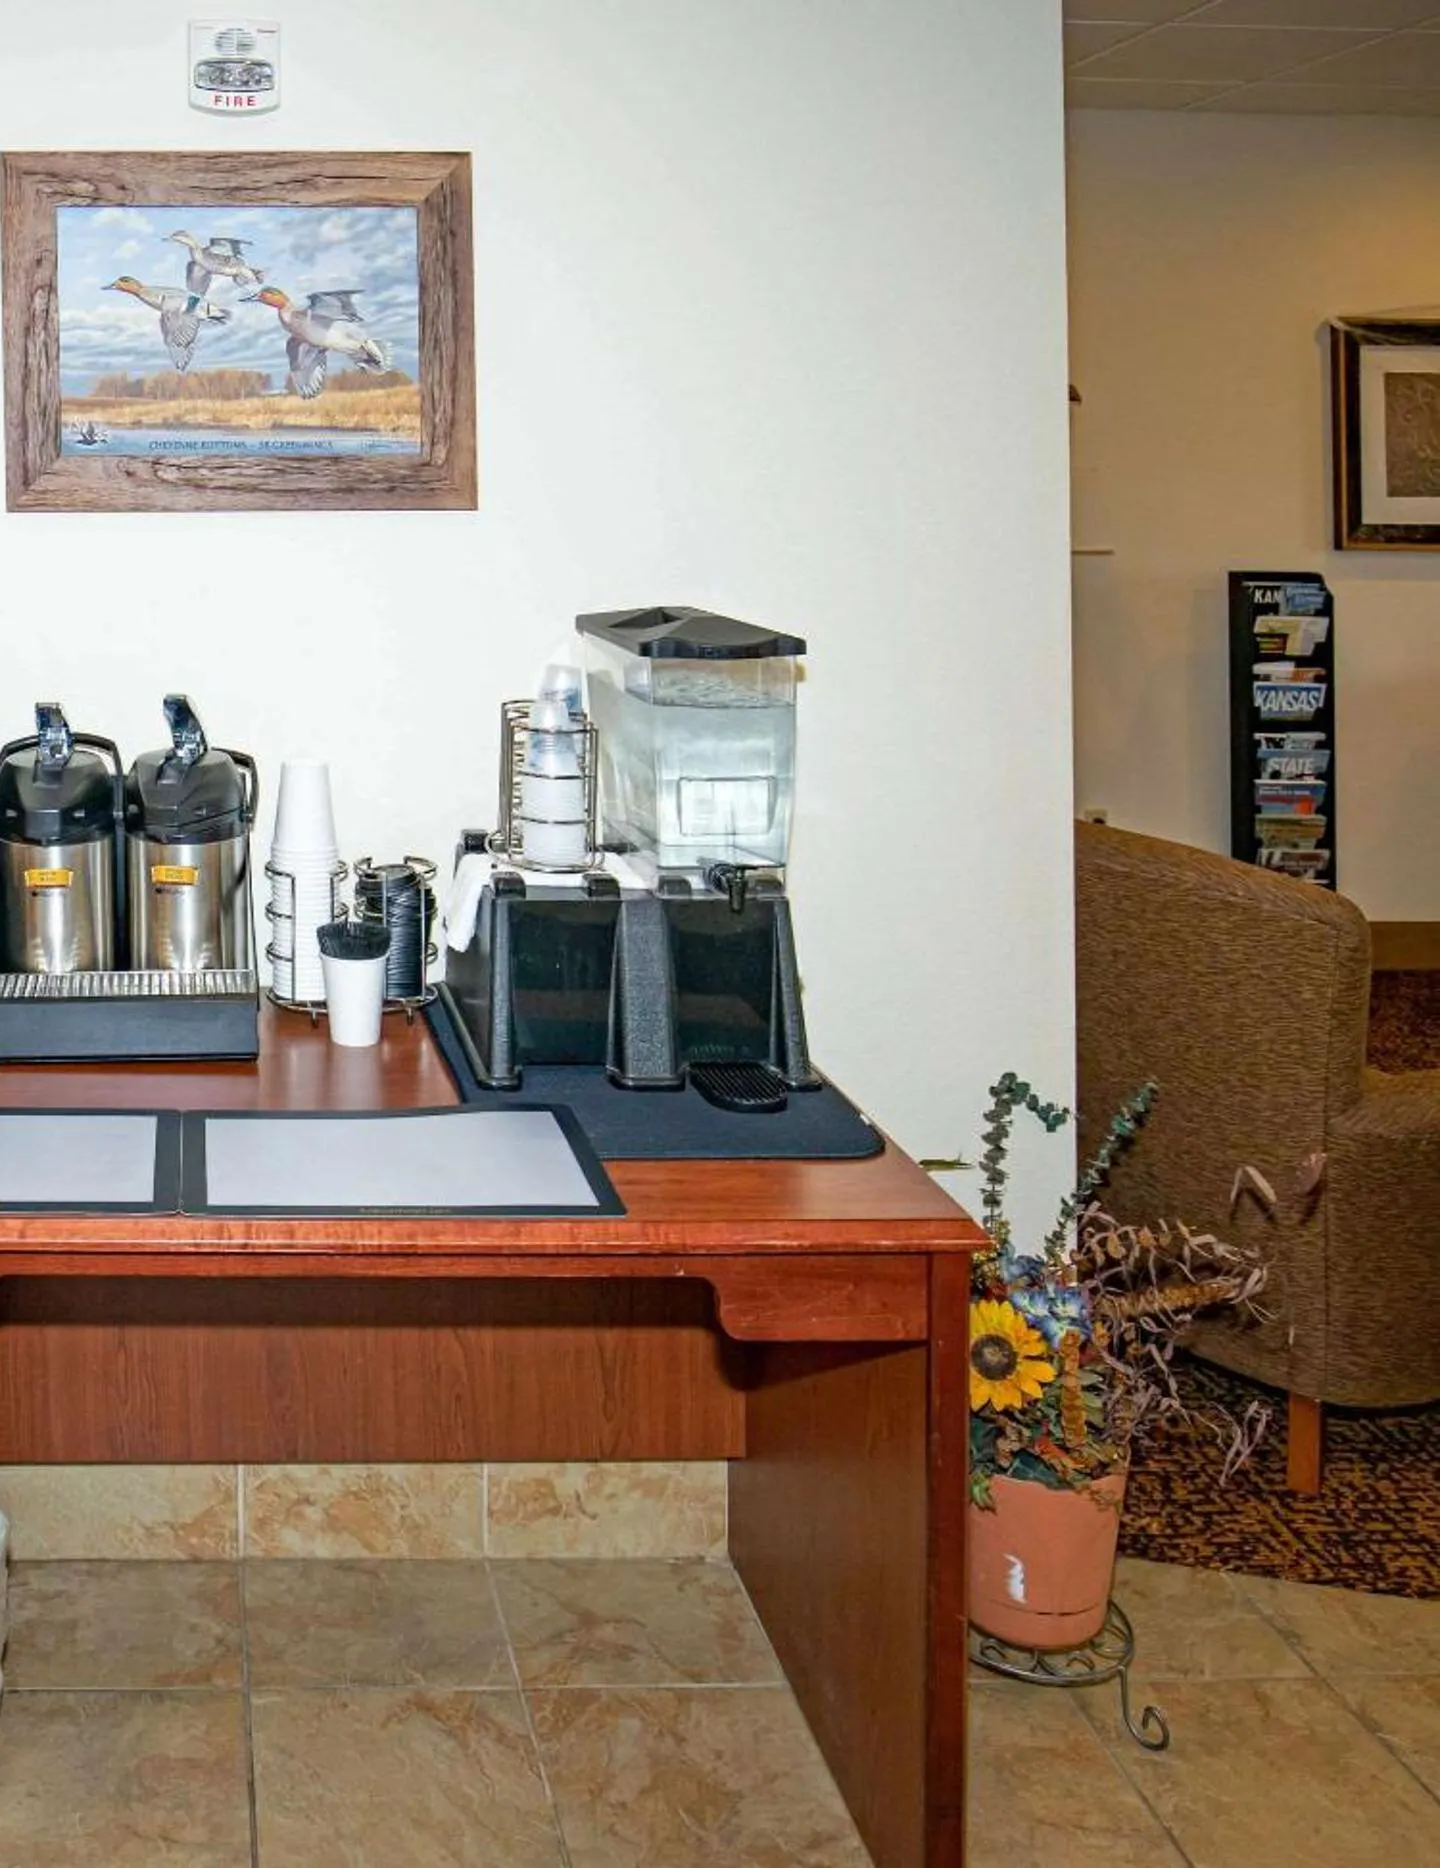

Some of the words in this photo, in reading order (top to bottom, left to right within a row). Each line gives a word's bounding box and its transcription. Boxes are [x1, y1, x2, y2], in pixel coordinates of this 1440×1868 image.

[214, 95, 256, 107] FIRE
[1255, 688, 1320, 711] KANSAS
[1267, 756, 1316, 774] STATE
